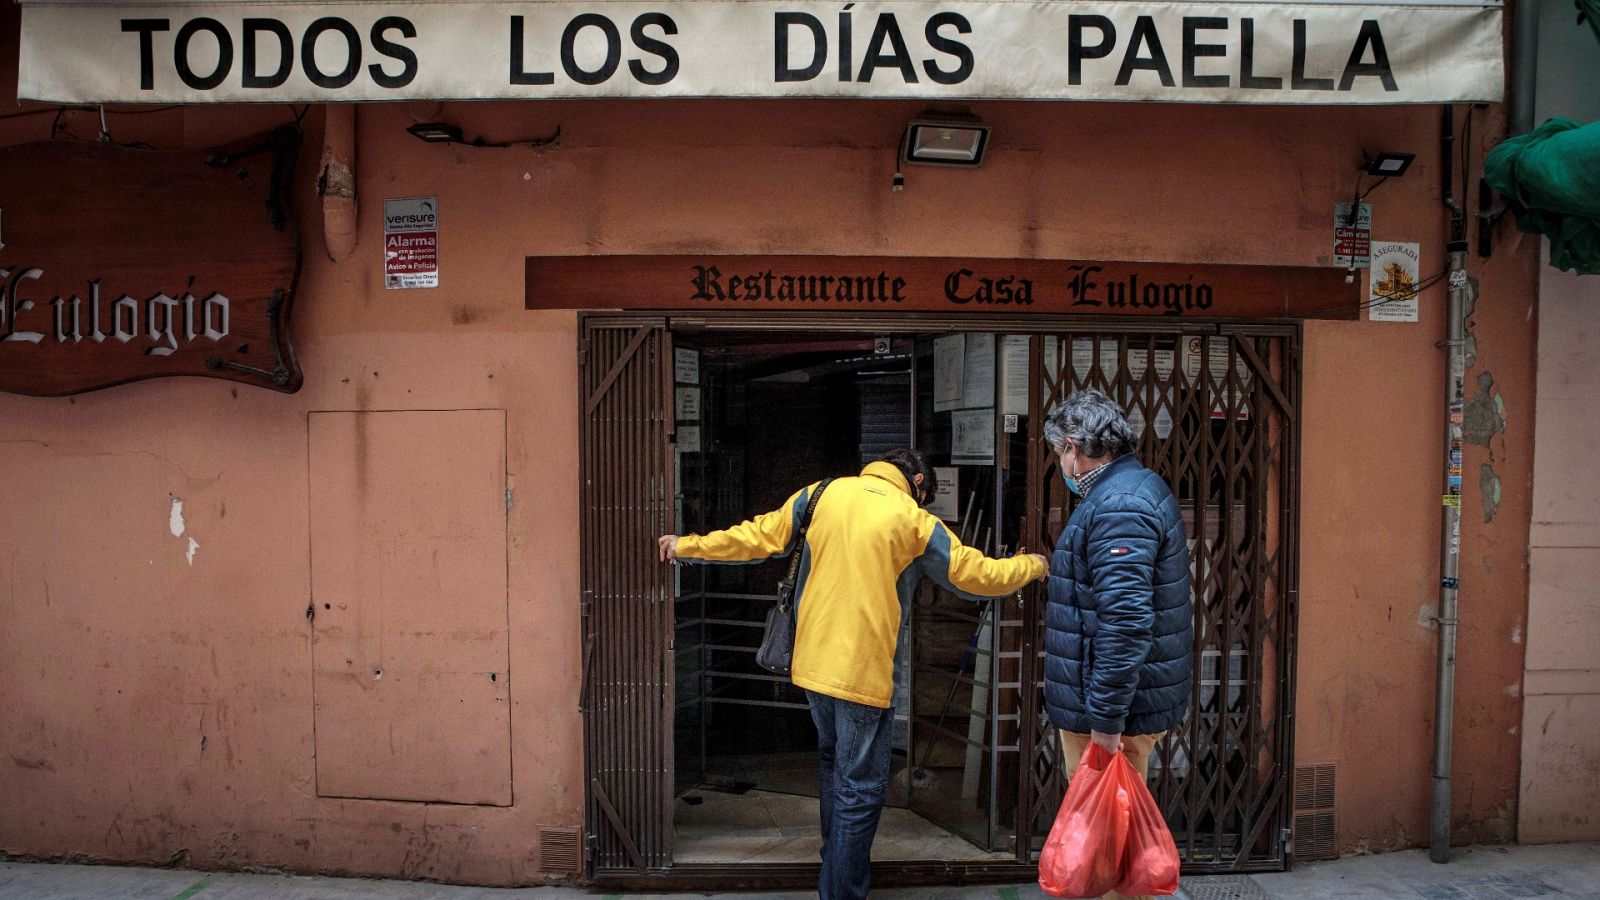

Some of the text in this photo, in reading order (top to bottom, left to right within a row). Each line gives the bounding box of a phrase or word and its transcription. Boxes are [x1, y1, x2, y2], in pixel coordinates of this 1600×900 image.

[121, 3, 1399, 91] TODOS LOS DÍAS PAELLA
[387, 214, 435, 224] verisure
[388, 235, 436, 247] Alarma
[1336, 229, 1369, 238] Cámras
[1373, 244, 1418, 262] ASEGURADA
[690, 264, 1213, 316] Restaurante Casa Eulogio
[0, 267, 229, 356] Eulogio
